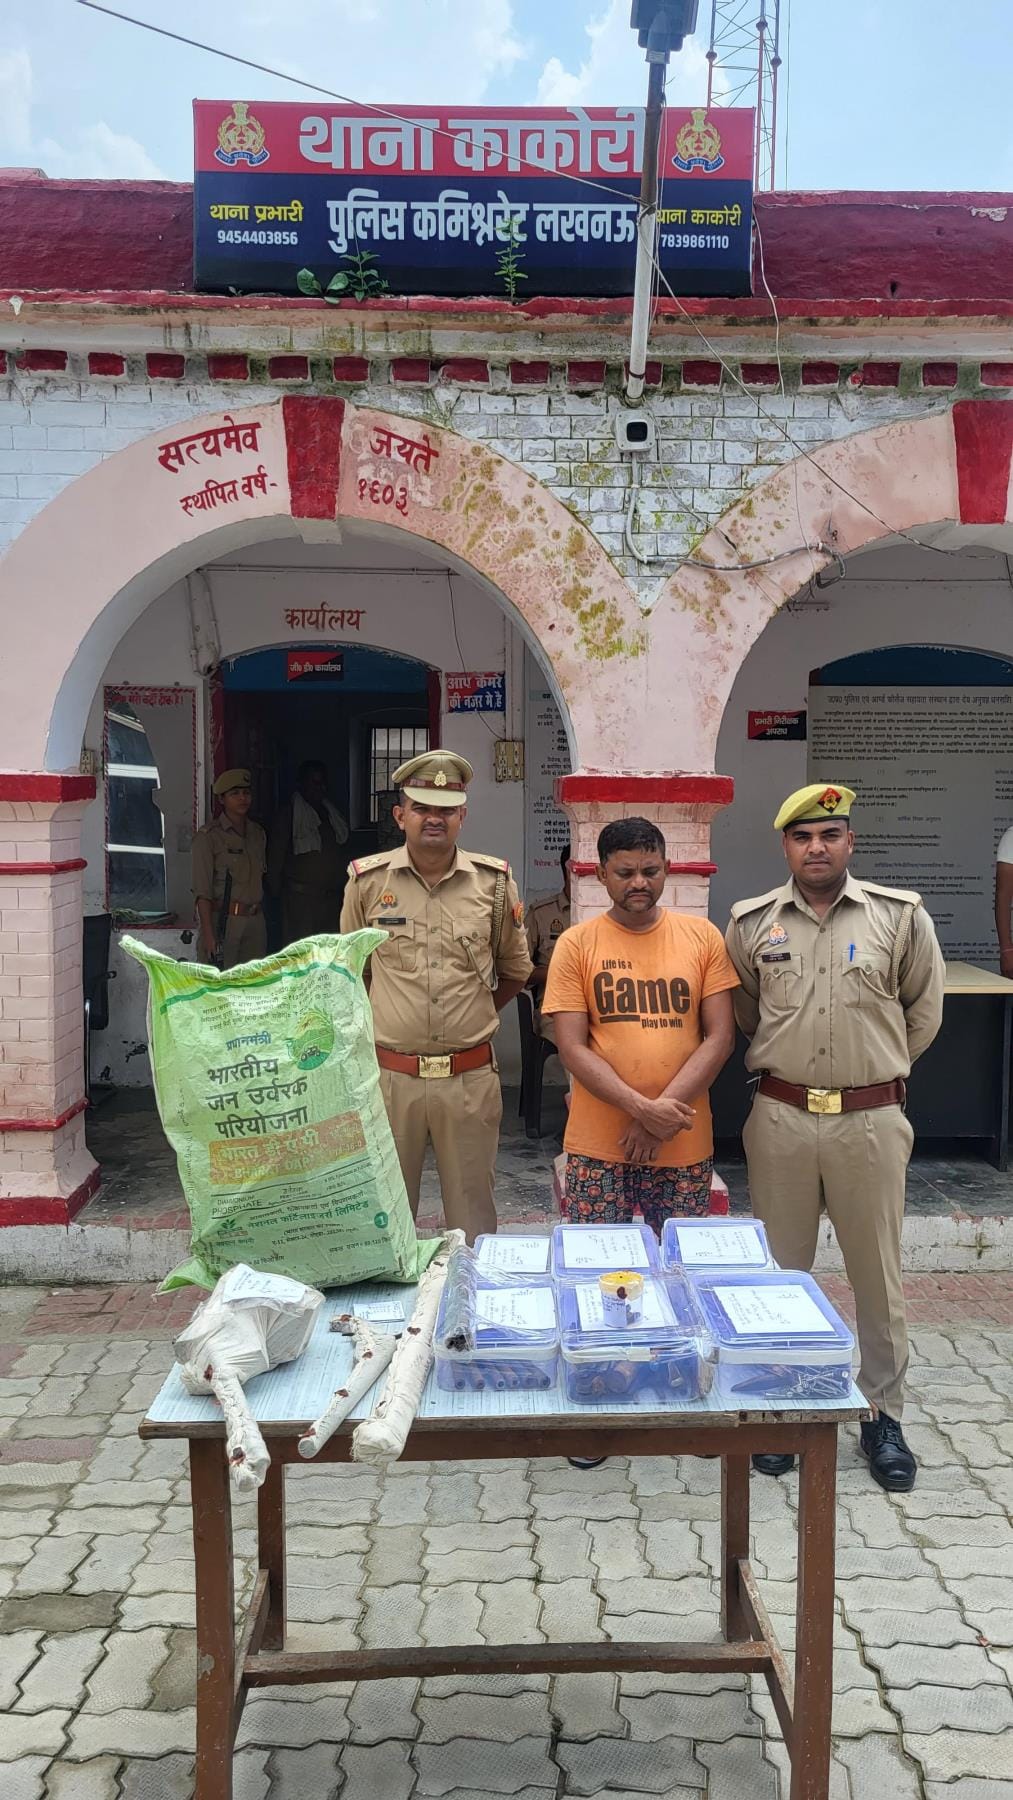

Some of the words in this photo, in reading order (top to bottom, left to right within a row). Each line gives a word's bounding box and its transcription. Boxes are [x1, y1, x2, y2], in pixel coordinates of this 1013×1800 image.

[299, 116, 440, 171] थाना
[447, 107, 647, 173] काकोरी
[209, 203, 249, 221] थाना
[254, 200, 304, 224] प्रभारी
[327, 188, 407, 254] पुलिस
[533, 203, 638, 243] लखनऊ
[655, 209, 687, 225] थाना
[691, 203, 742, 227] काकोरी
[217, 229, 299, 246] 9454403856
[660, 234, 730, 249] 7839861110
[158, 415, 262, 474] सत्यमेव
[369, 426, 439, 474] जयते
[180, 478, 238, 518] स्थापित
[284, 601, 367, 632] कार्यालय
[447, 676, 471, 690] आप
[448, 693, 461, 709] की
[754, 715, 772, 726] प्रभारी
[774, 715, 800, 725] निरीक्षक
[602, 959, 616, 970] Life
[618, 958, 626, 970] is
[627, 961, 632, 970] a
[593, 971, 691, 1015] Game
[641, 1018, 658, 1029] play
[660, 1017, 668, 1028] to
[669, 1016, 683, 1029] win
[207, 1054, 279, 1085] भारतीय
[206, 1092, 239, 1112] जन
[246, 1076, 308, 1106] उर्वरक
[215, 1106, 309, 1139] परियोजना
[219, 1145, 259, 1161] भारत
[285, 1156, 311, 1170] DAP
[212, 1199, 262, 1215] PHOSPHATE
[335, 1200, 369, 1217] लिमिटेड
